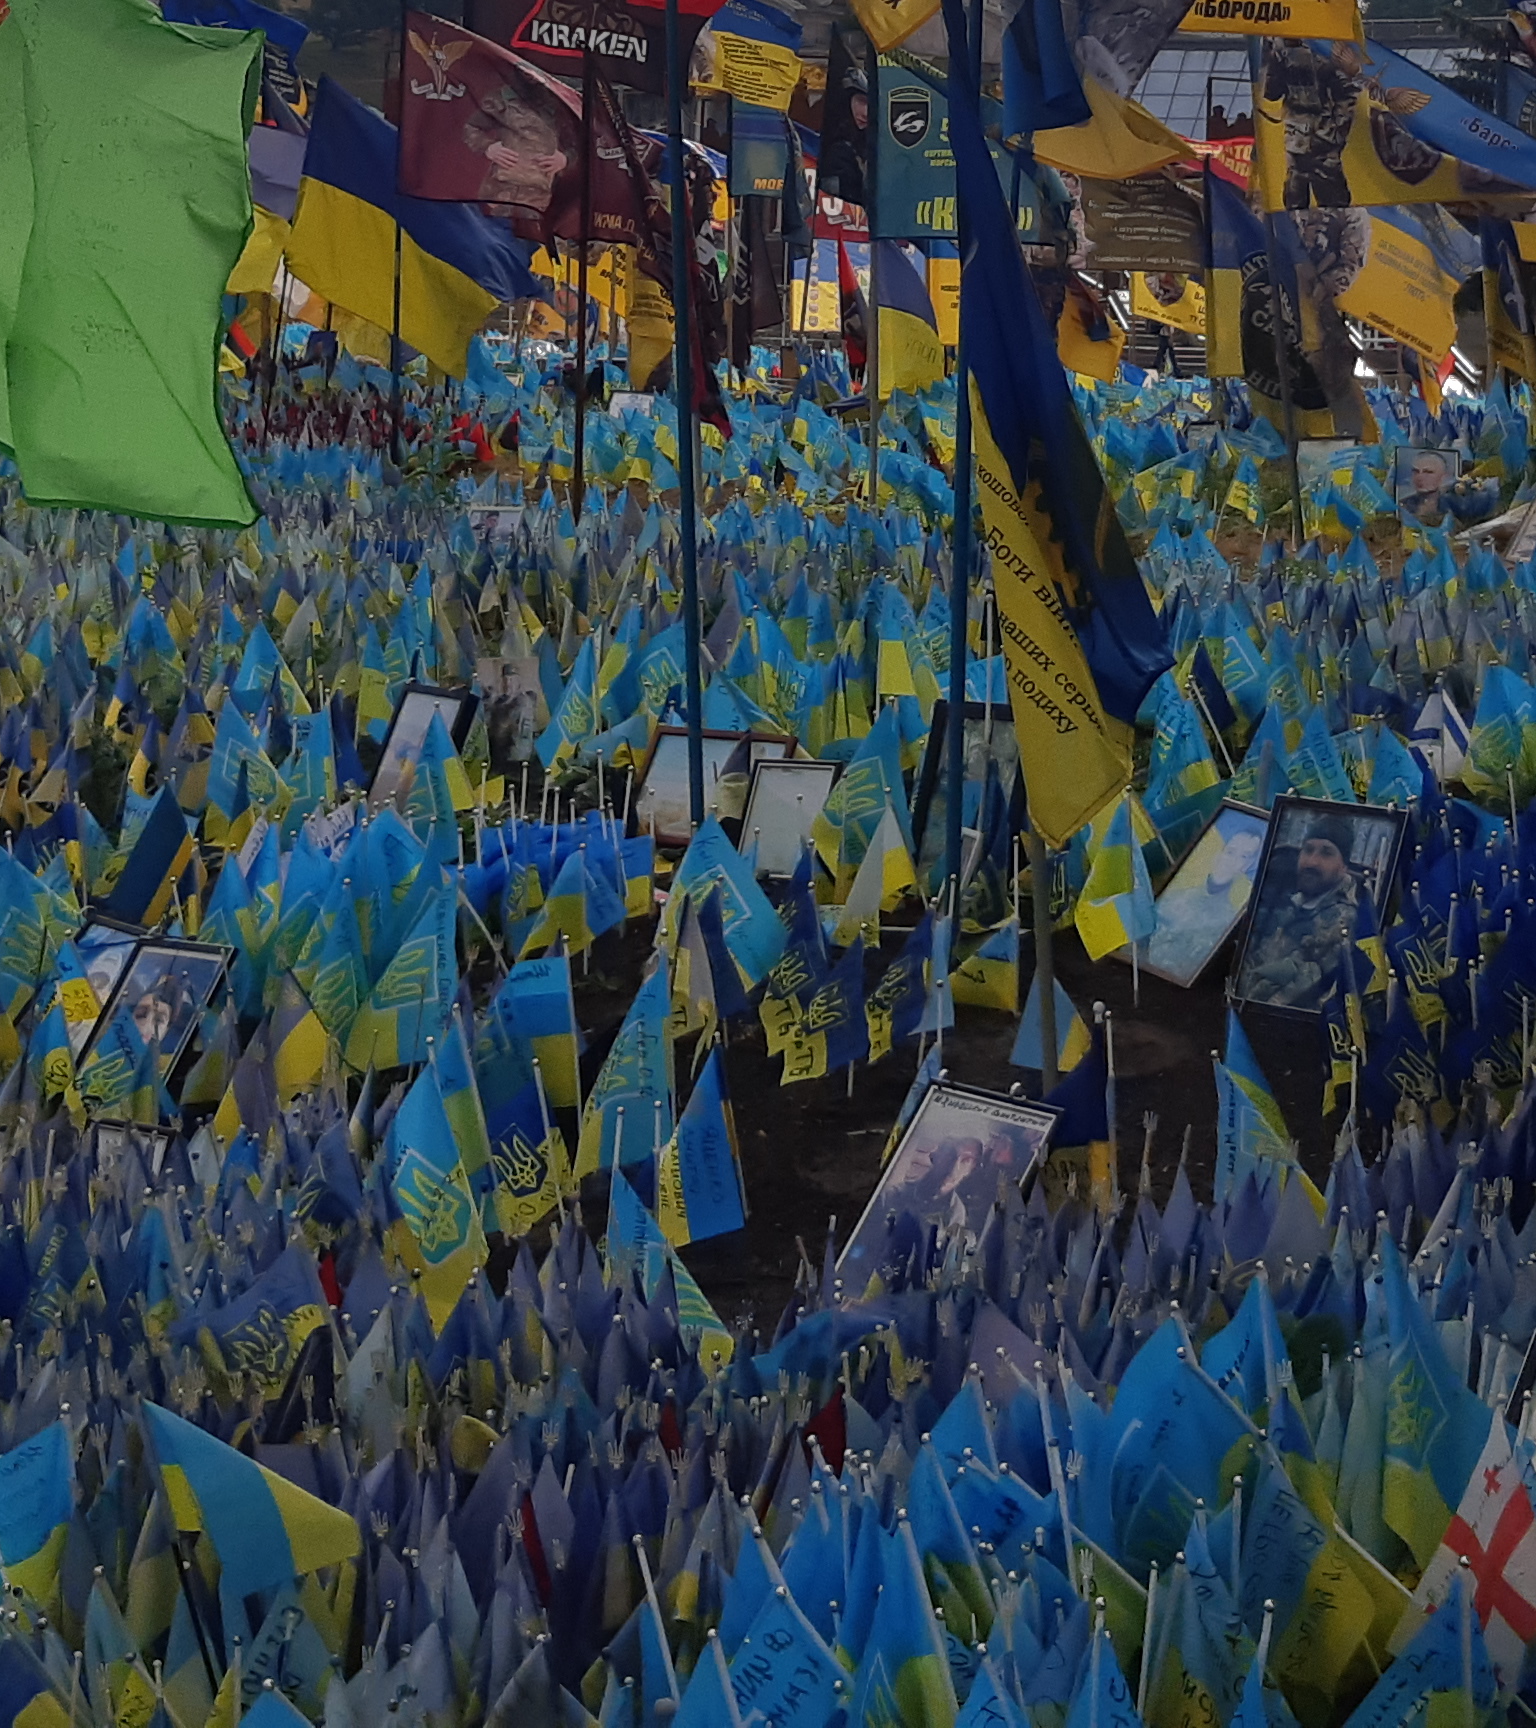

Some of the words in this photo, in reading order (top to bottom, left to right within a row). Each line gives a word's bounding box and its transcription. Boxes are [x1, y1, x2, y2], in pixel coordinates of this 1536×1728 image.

[530, 20, 649, 63] KRAKEN
[986, 524, 1036, 585] Боги
[1012, 668, 1079, 734] подиху
